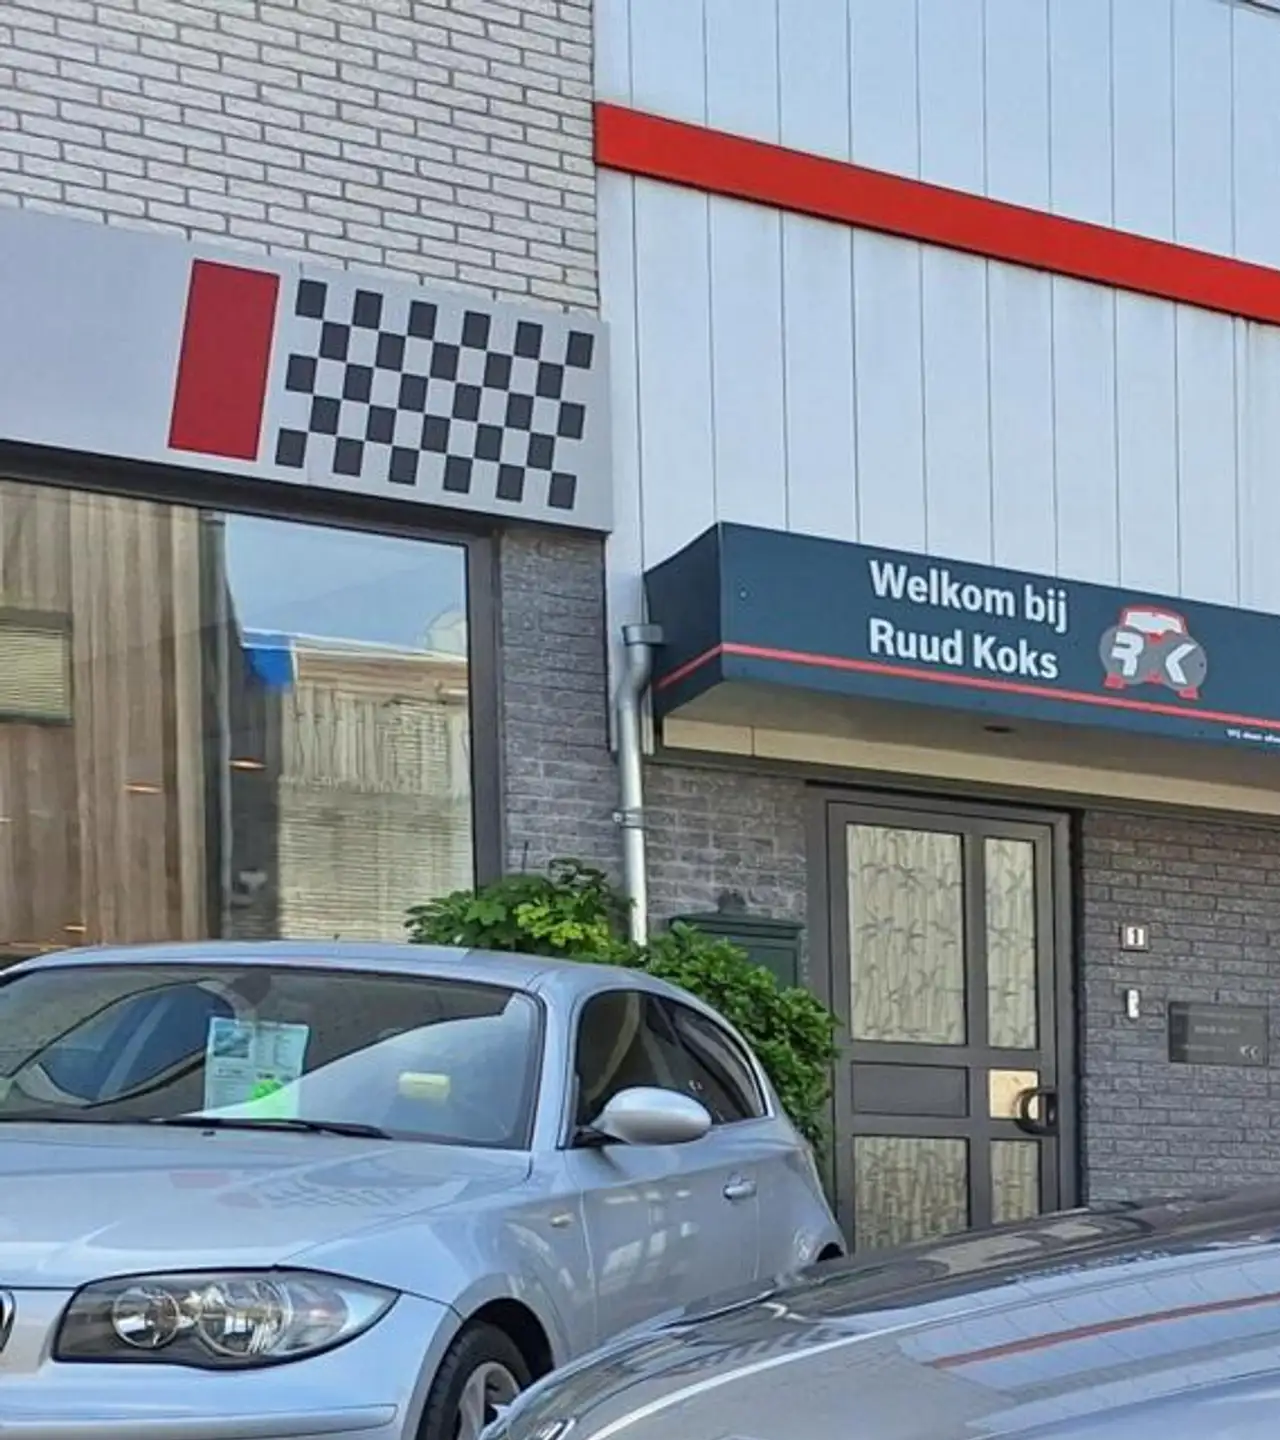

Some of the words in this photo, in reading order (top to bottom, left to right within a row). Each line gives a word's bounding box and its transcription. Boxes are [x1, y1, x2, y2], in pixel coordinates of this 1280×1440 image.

[868, 560, 1015, 618] Welkom
[1024, 584, 1068, 634] bij
[869, 617, 964, 666] Ruud
[973, 633, 1059, 680] Koks
